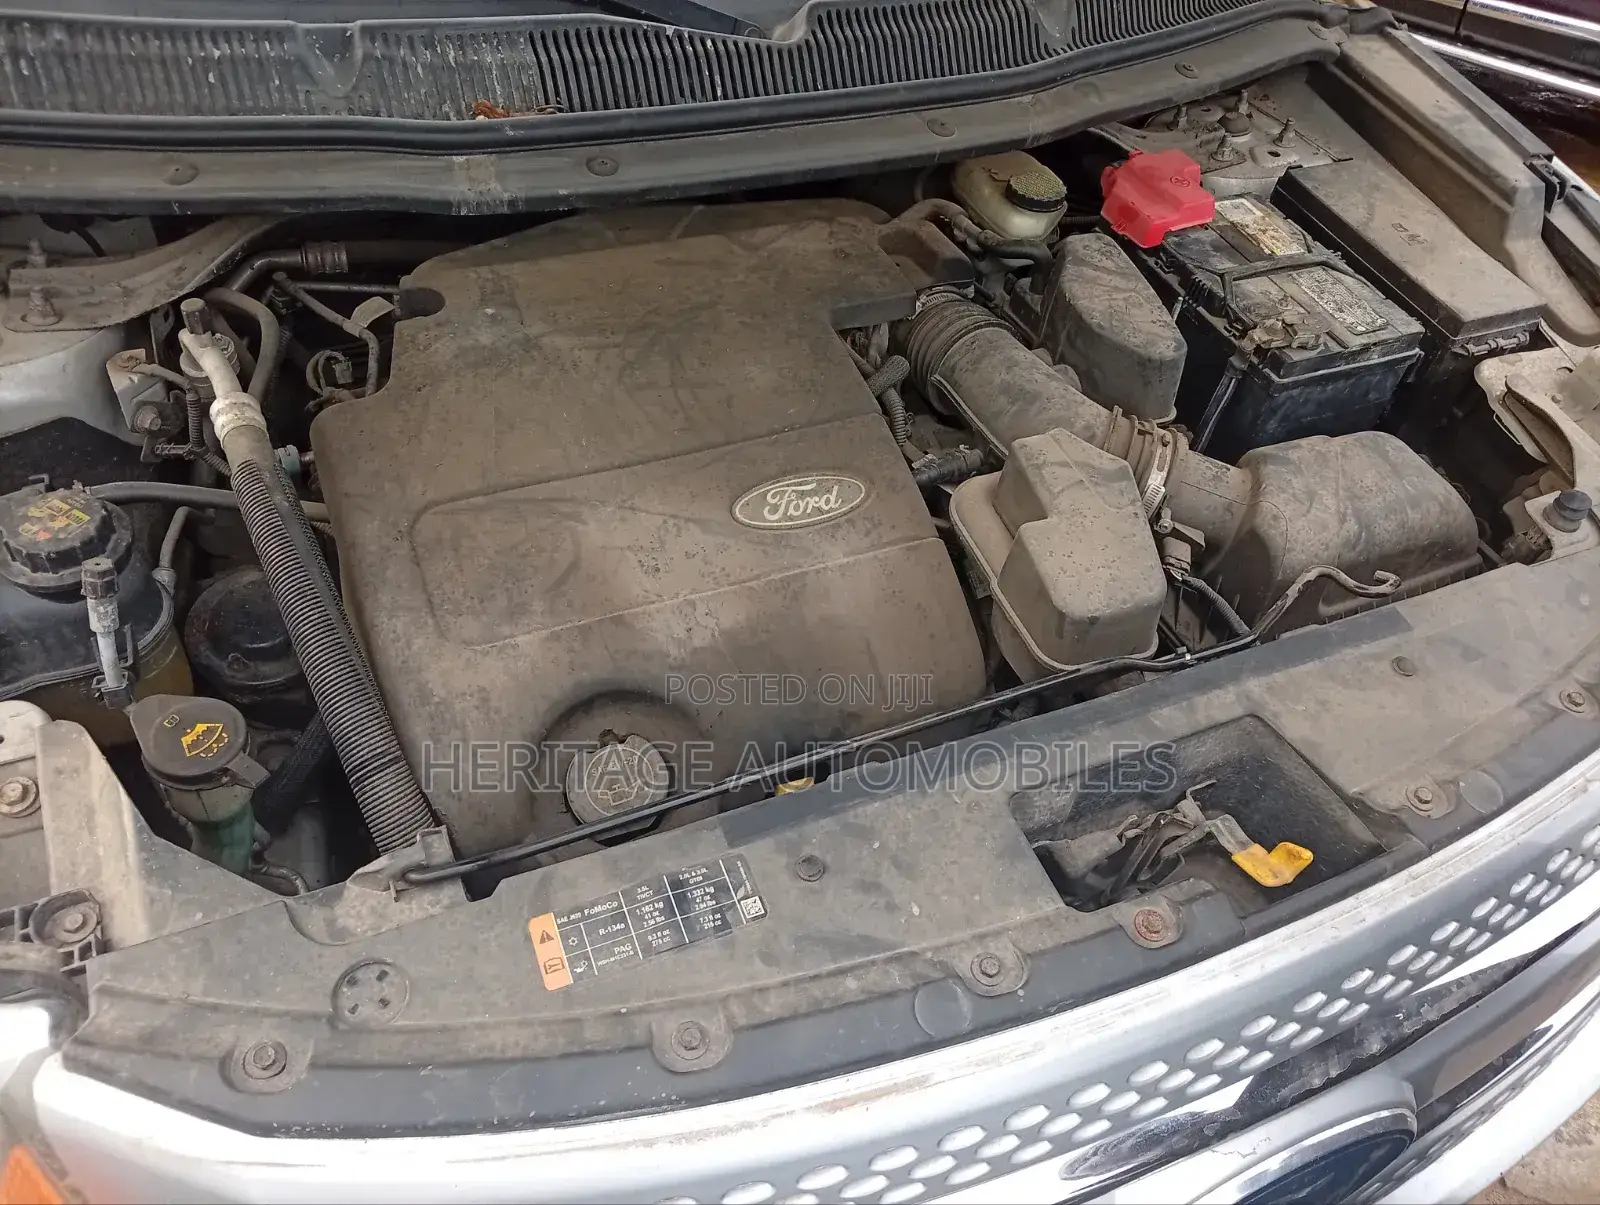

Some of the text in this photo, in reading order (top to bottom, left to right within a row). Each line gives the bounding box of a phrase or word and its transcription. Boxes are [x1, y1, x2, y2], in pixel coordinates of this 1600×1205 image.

[763, 483, 841, 520] Ford
[654, 901, 664, 909] kg
[556, 915, 569, 925] SAE
[584, 901, 618, 916] FoMoCo
[599, 923, 626, 936] R-134a
[614, 943, 632, 954] PAG
